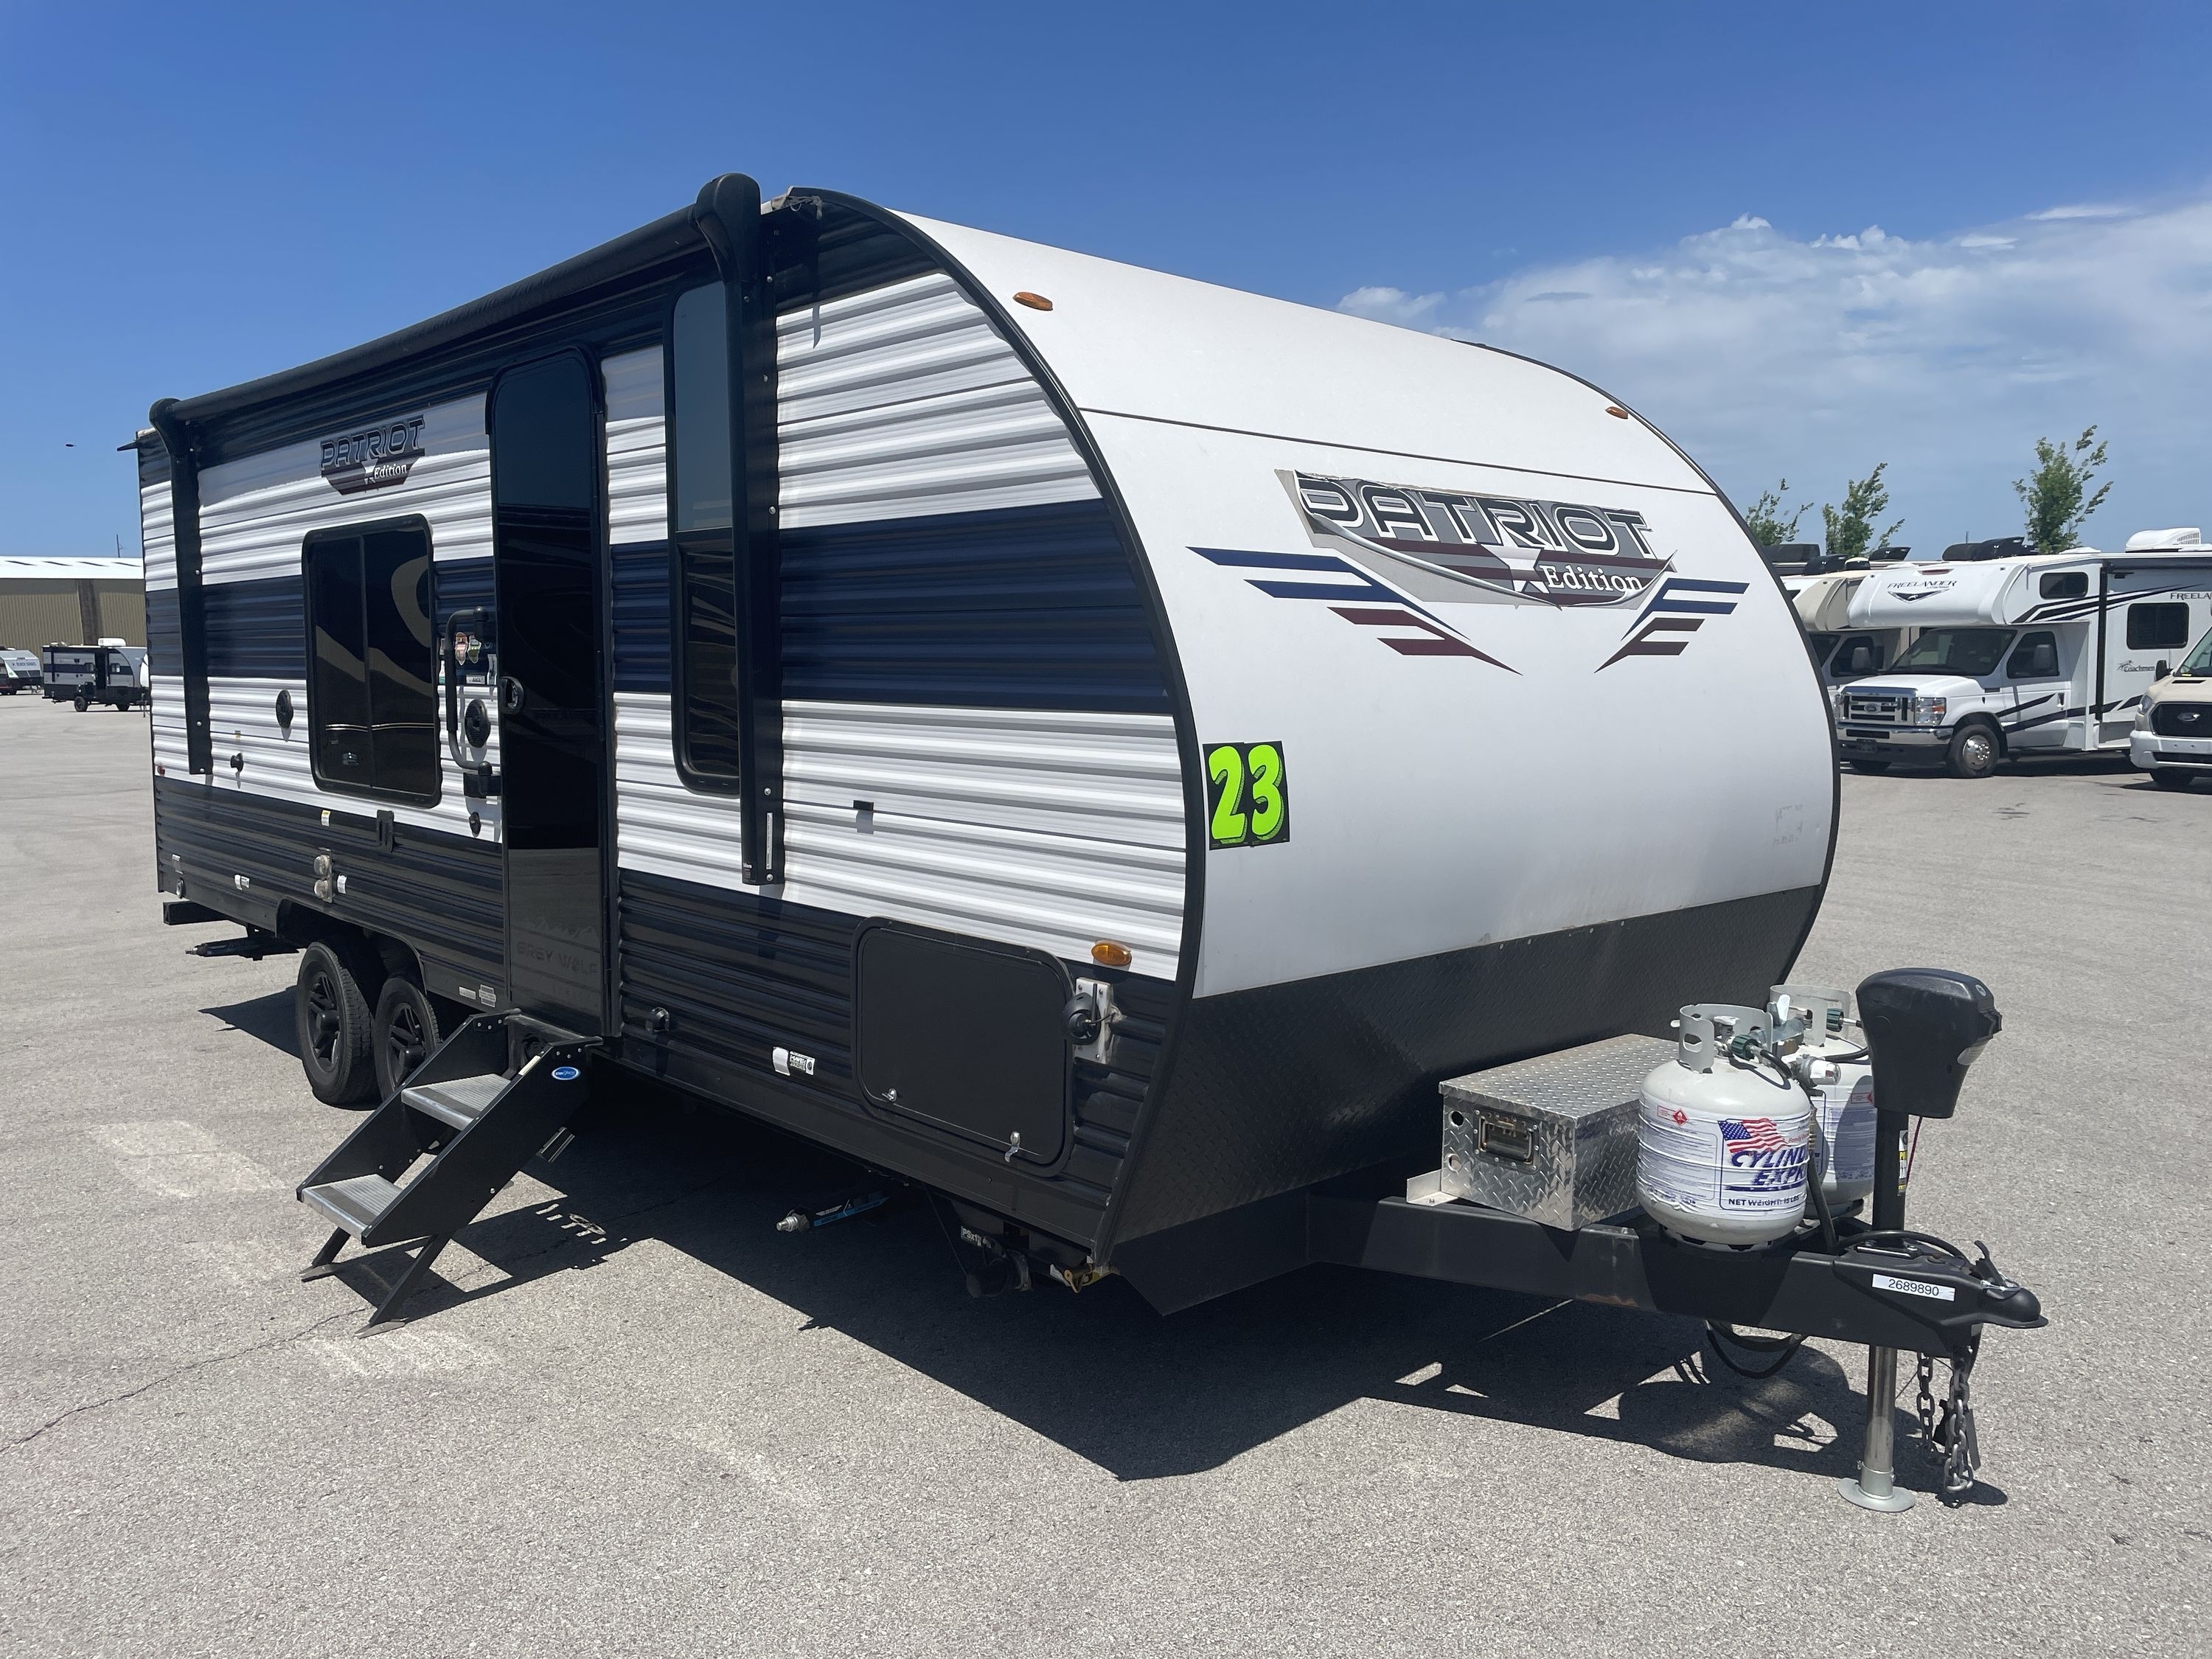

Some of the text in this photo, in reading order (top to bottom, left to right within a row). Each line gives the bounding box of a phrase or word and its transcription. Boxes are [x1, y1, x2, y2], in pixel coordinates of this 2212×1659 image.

[320, 417, 425, 471] PATRIOT
[374, 463, 407, 479] Edition
[1297, 476, 1656, 560] PATRIOT
[1539, 563, 1644, 592] Edition
[1888, 580, 1958, 589] FREELANDER
[1208, 744, 1284, 845] 23
[1888, 1279, 1939, 1296] 2689890
